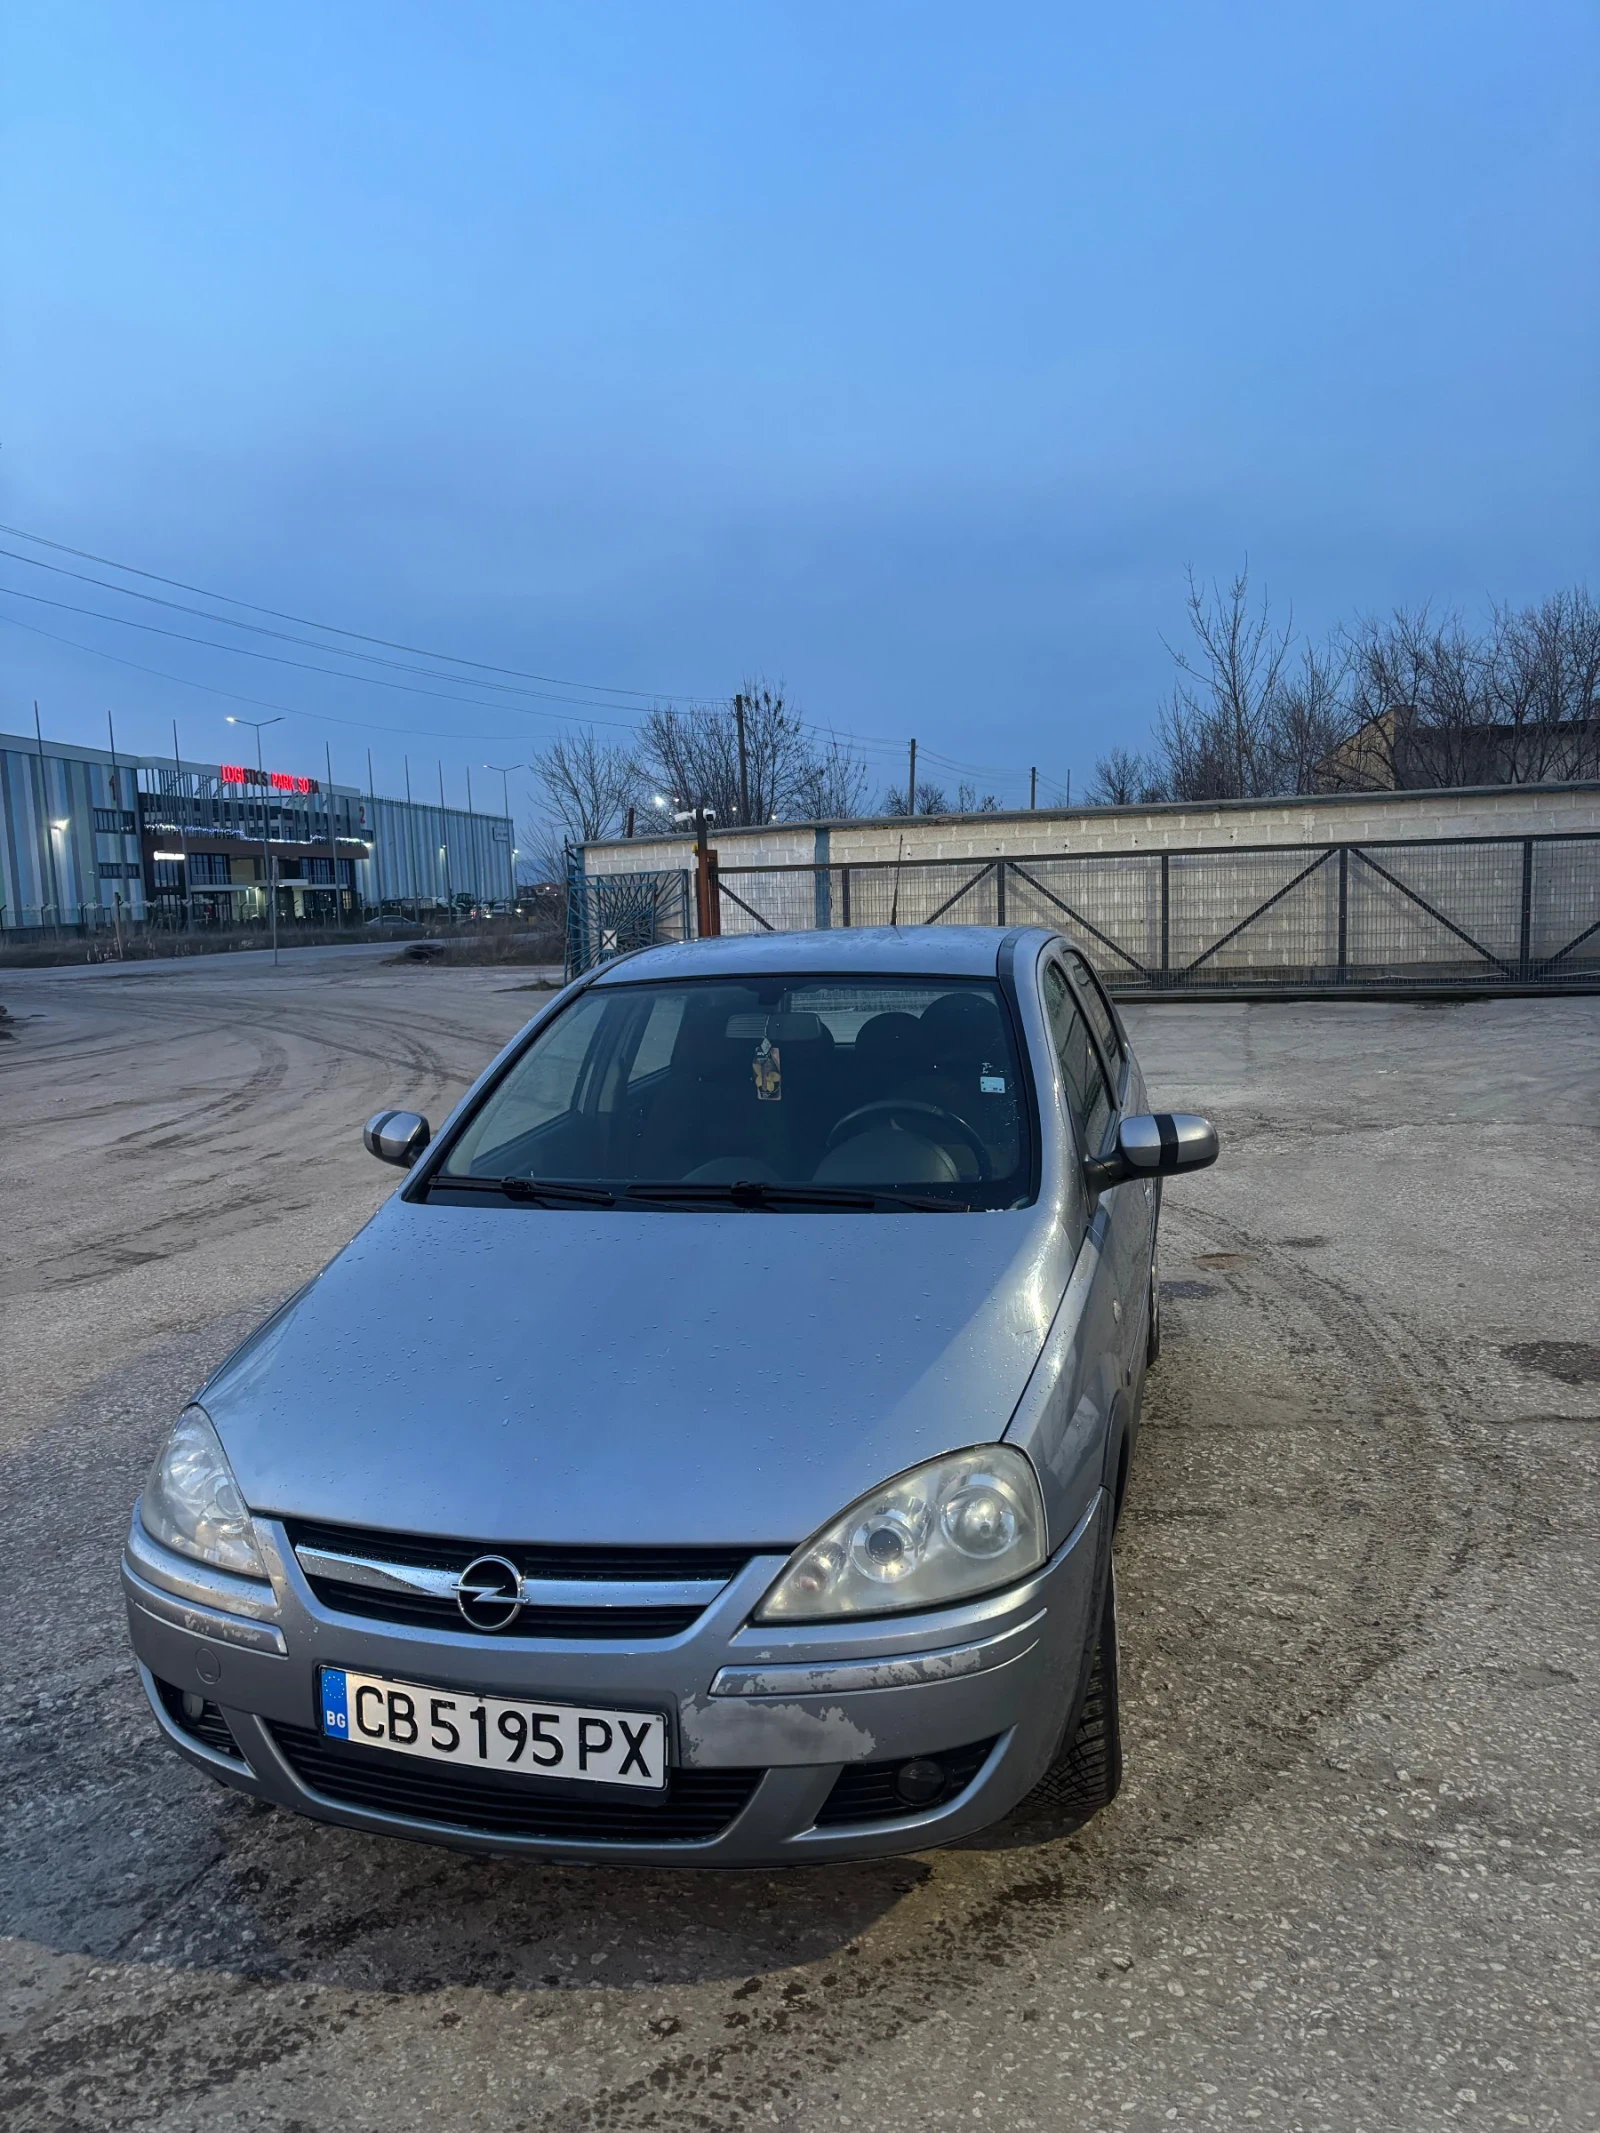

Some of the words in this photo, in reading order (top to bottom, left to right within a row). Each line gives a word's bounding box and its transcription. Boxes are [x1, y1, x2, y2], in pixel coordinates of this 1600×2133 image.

[221, 764, 268, 787] LOGISTICS
[271, 772, 294, 791] PARK
[297, 777, 320, 794] SOFIA
[359, 806, 366, 824] 2
[326, 1710, 346, 1729] BG
[430, 1698, 564, 1767] 5195
